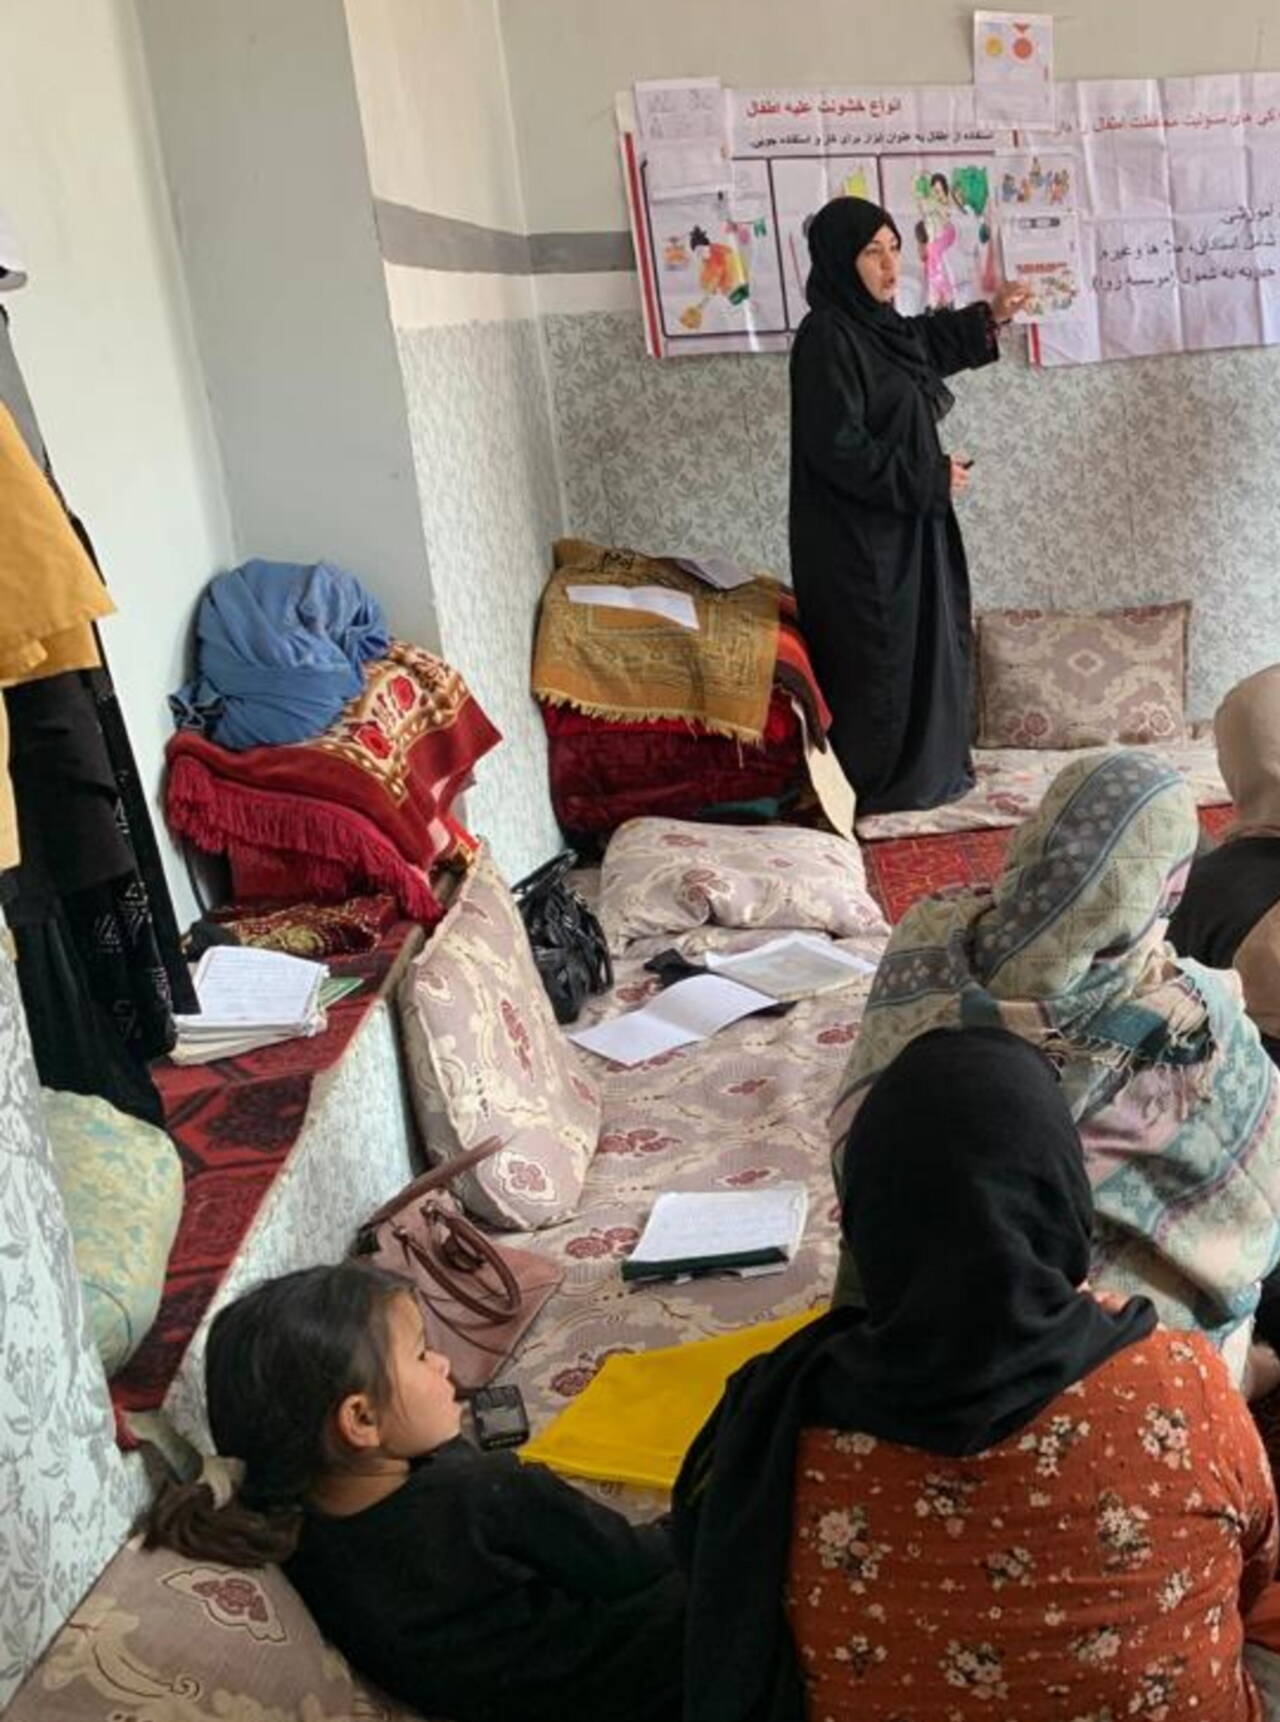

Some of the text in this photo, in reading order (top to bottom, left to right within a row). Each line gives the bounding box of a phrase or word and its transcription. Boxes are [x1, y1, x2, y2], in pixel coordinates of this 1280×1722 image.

[746, 100, 781, 118] اطفال
[817, 98, 866, 116] خشونت
[869, 98, 902, 118] انواع
